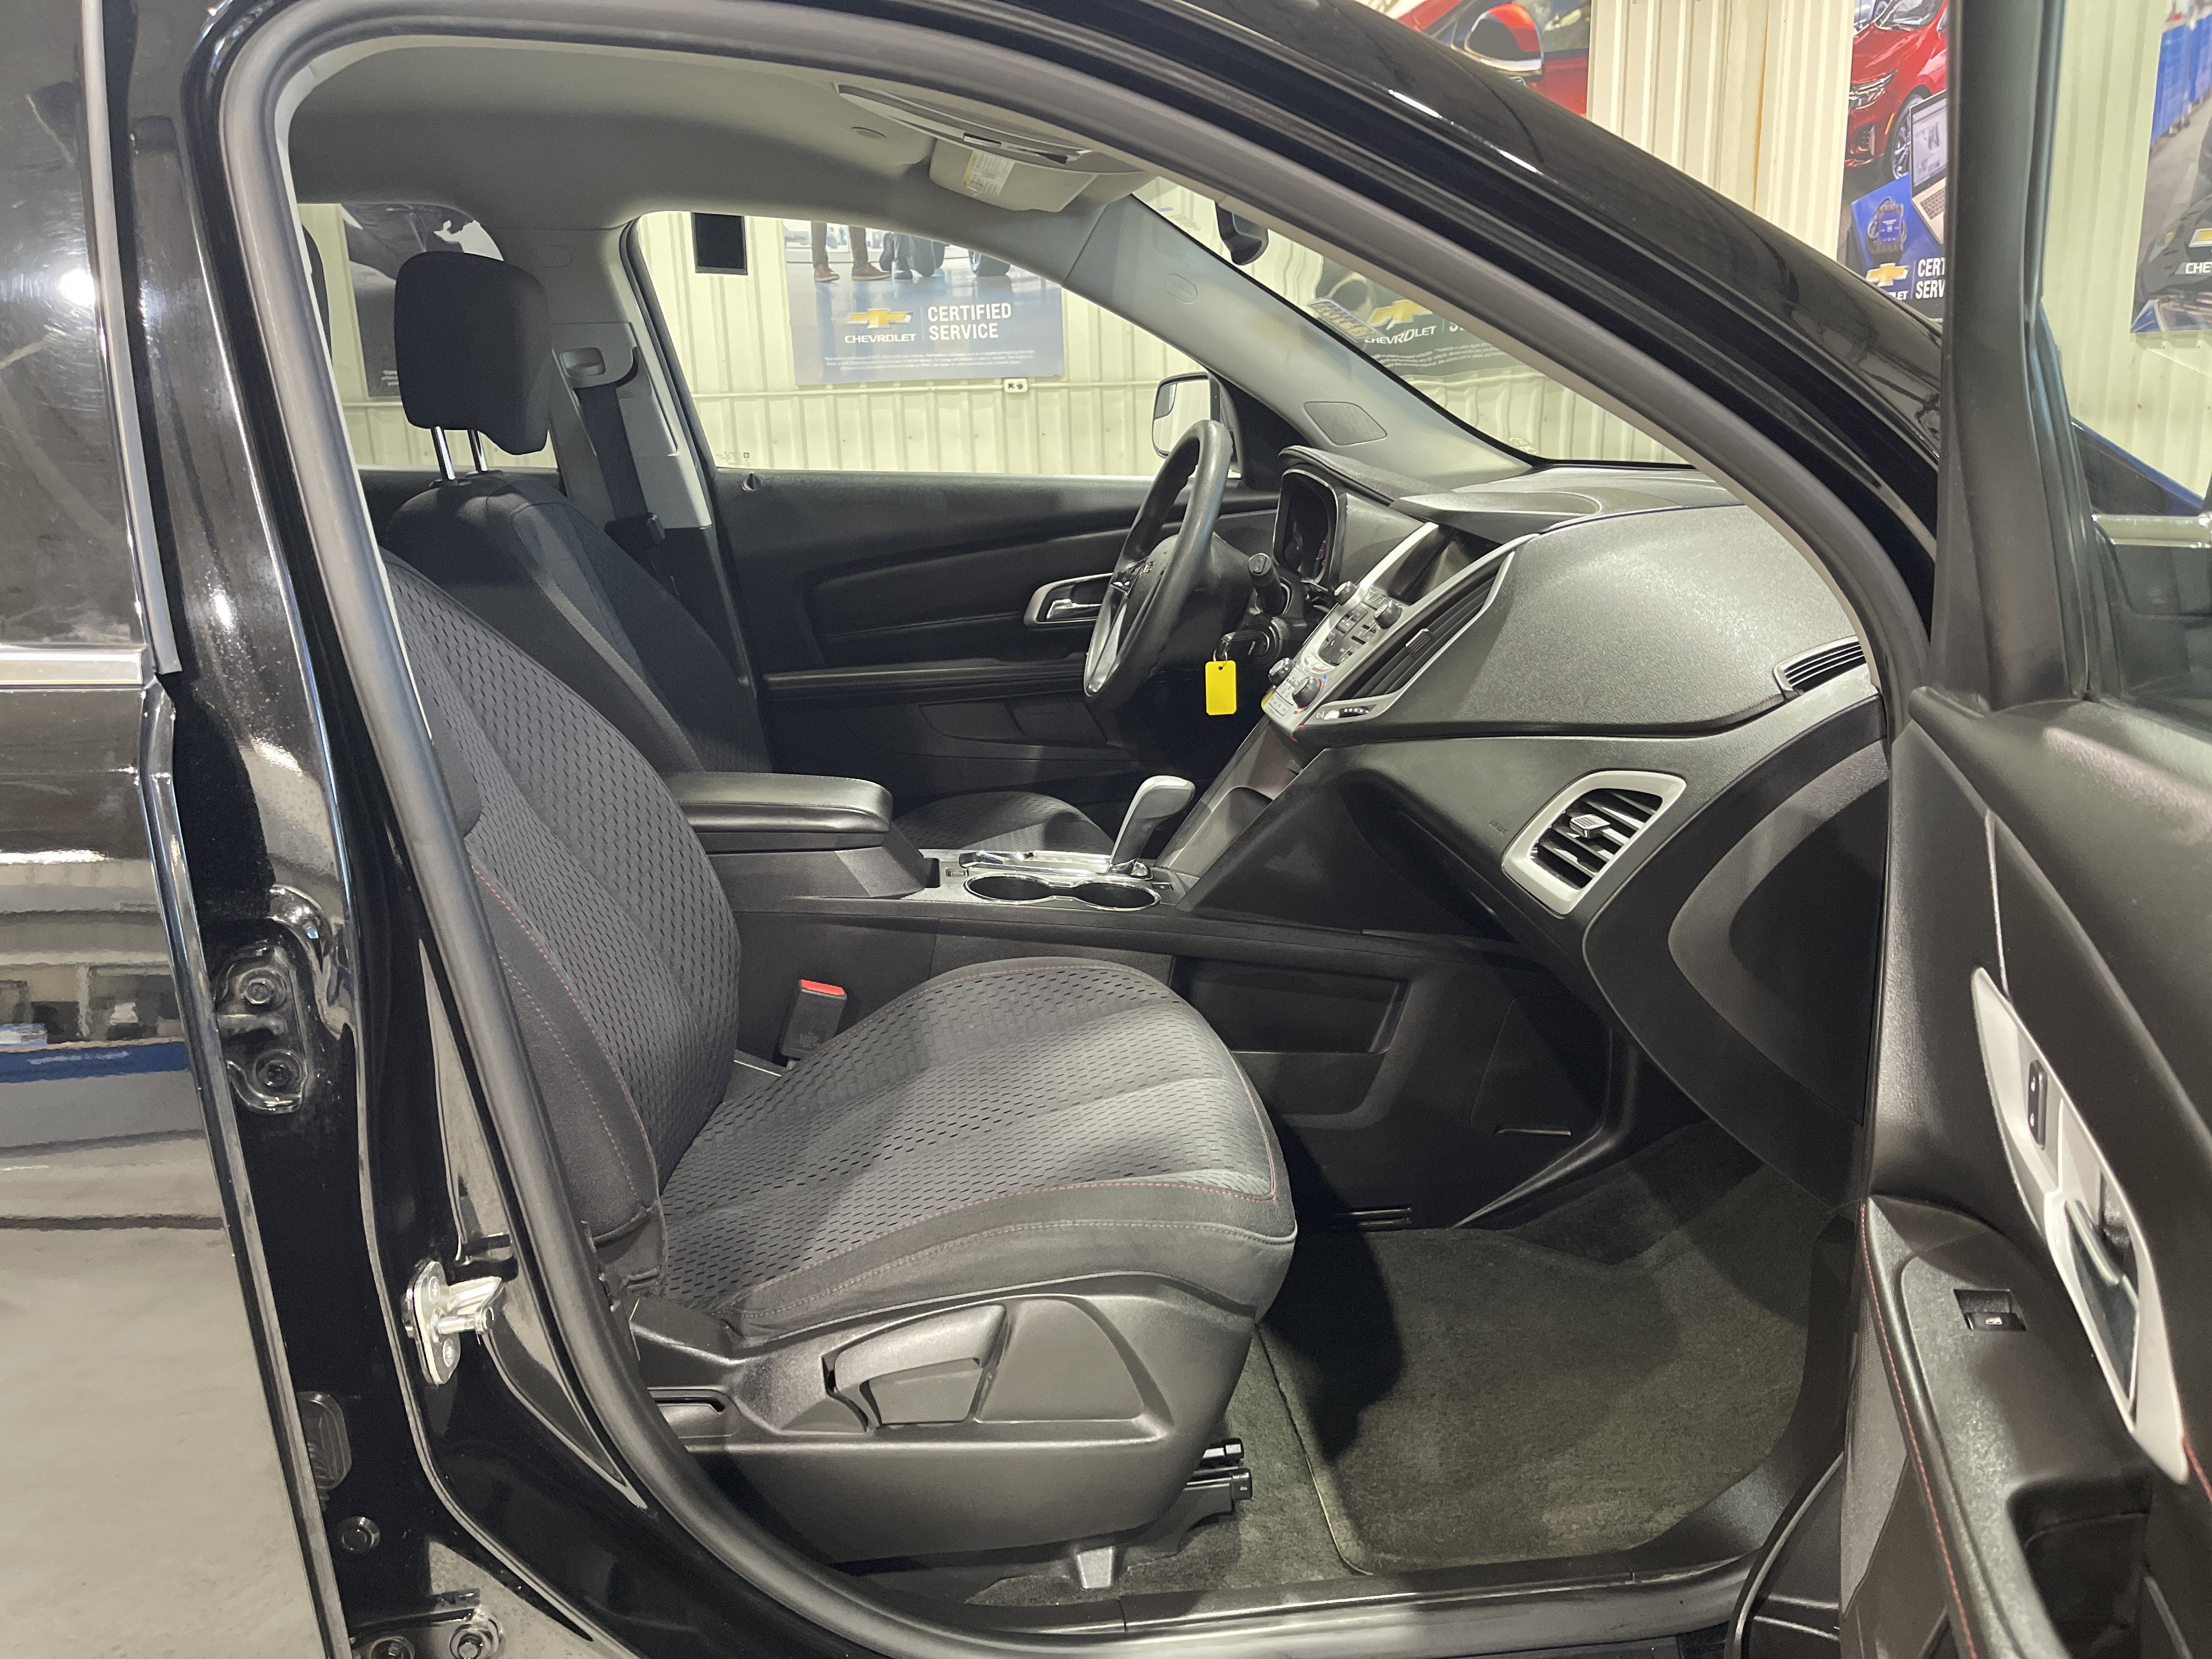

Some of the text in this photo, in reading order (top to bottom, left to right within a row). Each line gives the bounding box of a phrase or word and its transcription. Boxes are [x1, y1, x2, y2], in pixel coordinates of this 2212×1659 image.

[1917, 257, 1945, 277] CERT
[2185, 262, 2212, 274] CHE
[1915, 279, 1945, 300] SERV
[928, 303, 1012, 322] CERTIFIED
[844, 334, 917, 343] CHEVROLET
[929, 323, 999, 341] SERVICE
